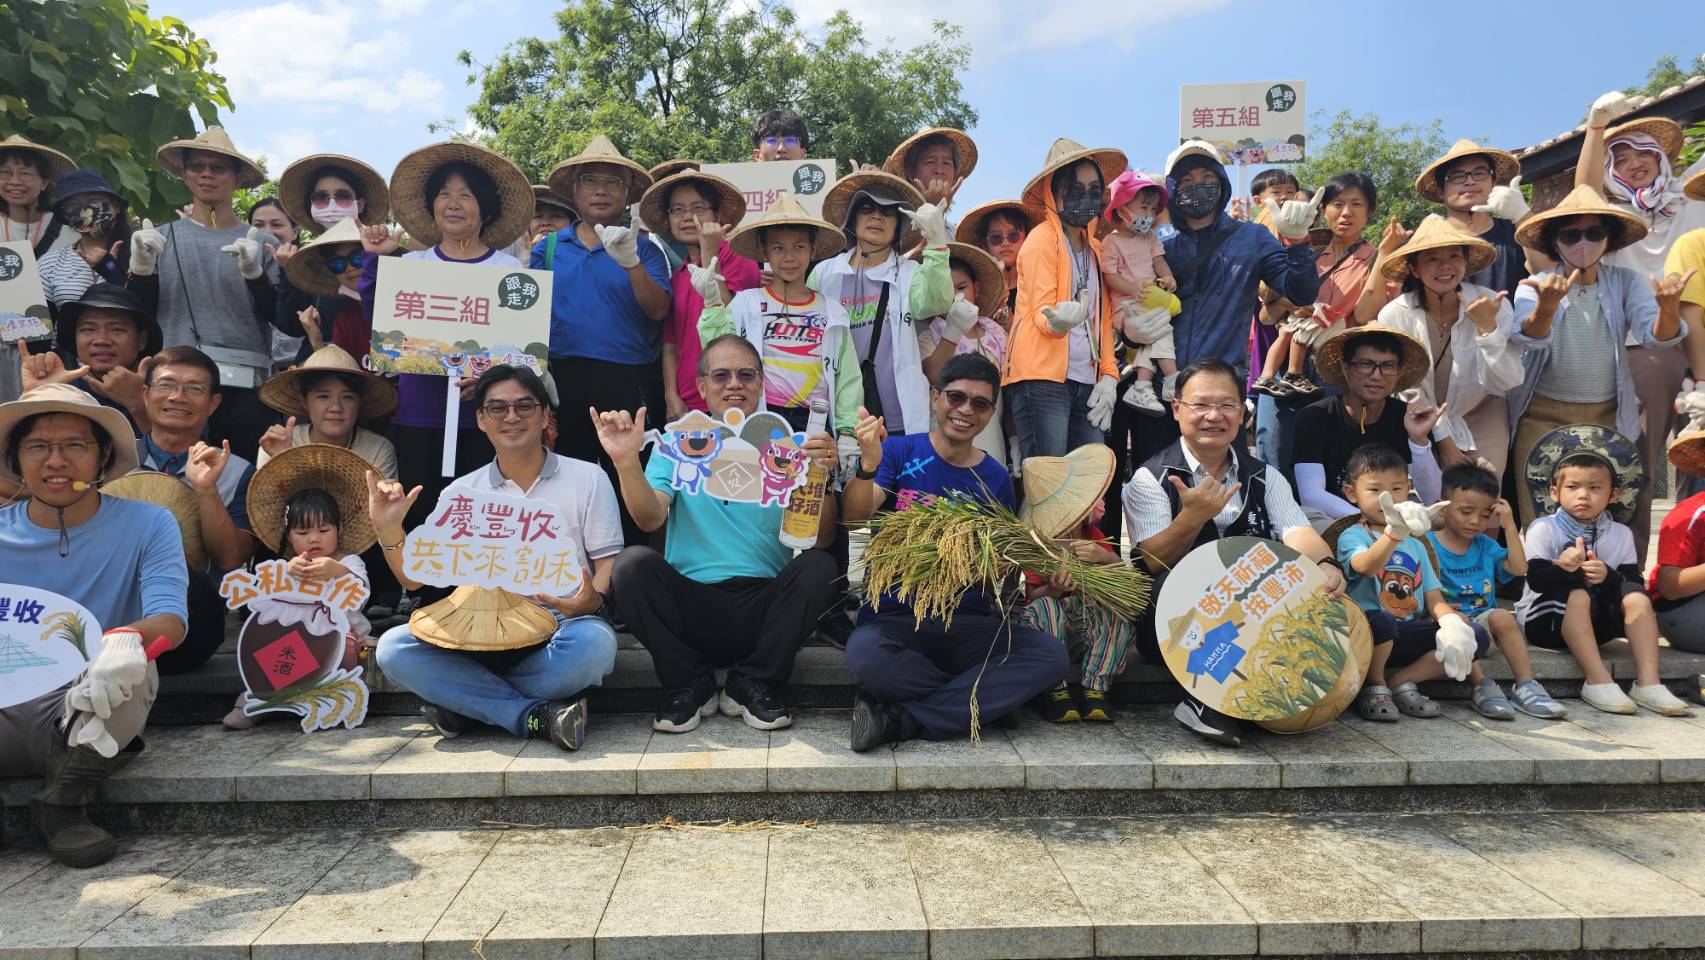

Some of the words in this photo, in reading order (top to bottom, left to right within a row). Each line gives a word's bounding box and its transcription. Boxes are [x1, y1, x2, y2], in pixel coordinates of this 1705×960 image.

[1192, 105, 1260, 128] 第五組
[798, 167, 823, 182] 跟我
[0, 254, 19, 267] 我
[505, 276, 537, 297] 跟我
[507, 293, 529, 308] 走!
[393, 290, 490, 325] 第三組
[434, 494, 557, 542] 慶豐收
[411, 537, 578, 587] 共下來割禾
[1198, 545, 1276, 615] 敬天祈福
[1245, 562, 1305, 621] 按豐沛
[274, 646, 297, 676] 米酒
